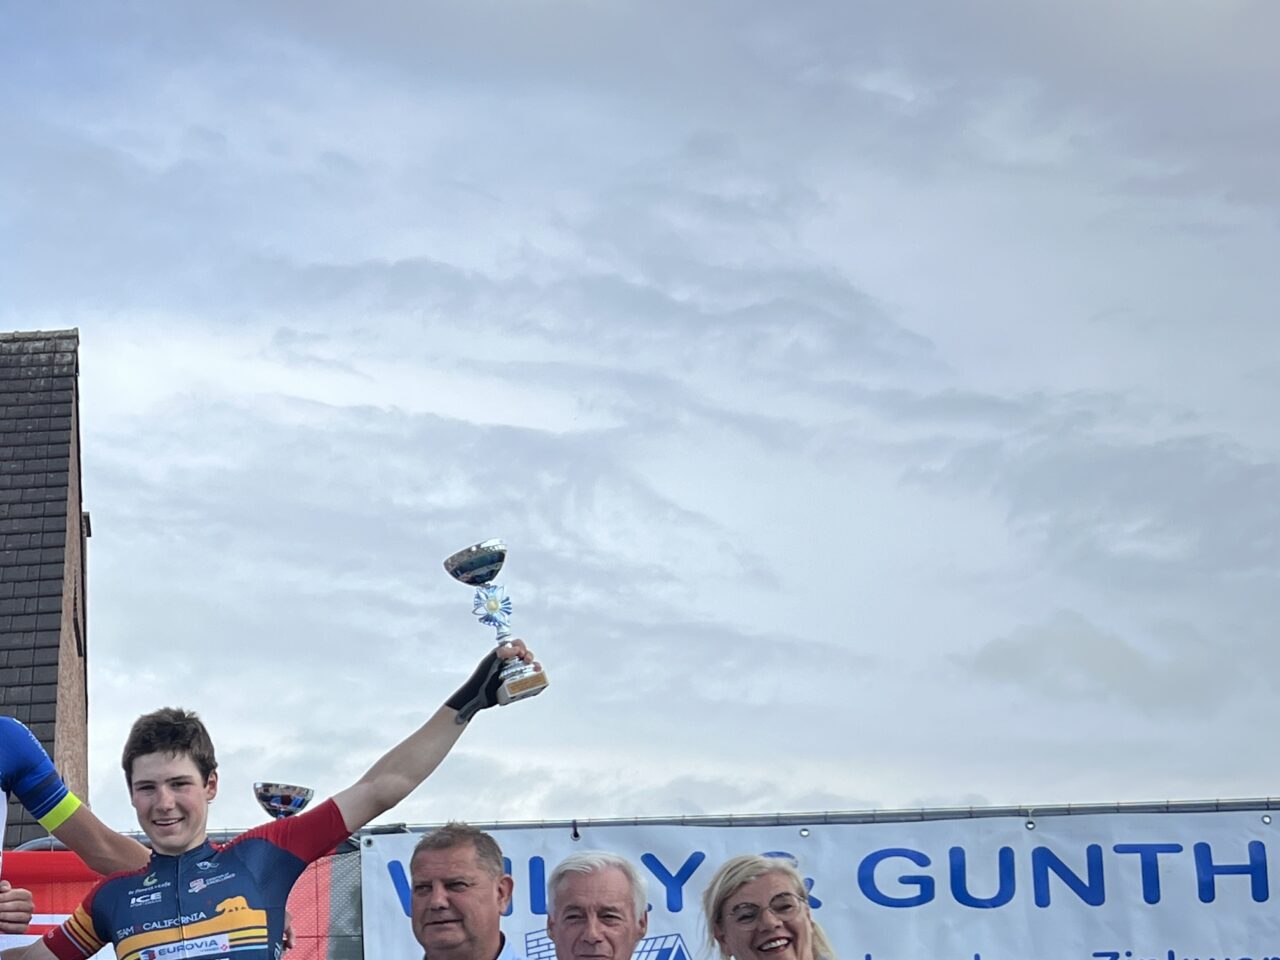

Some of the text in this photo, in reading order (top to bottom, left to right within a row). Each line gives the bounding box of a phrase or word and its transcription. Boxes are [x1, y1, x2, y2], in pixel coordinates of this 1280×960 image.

[856, 841, 1269, 909] GUNTH
[131, 892, 162, 904] ICE
[117, 911, 207, 939] EAM CALIFORNIA
